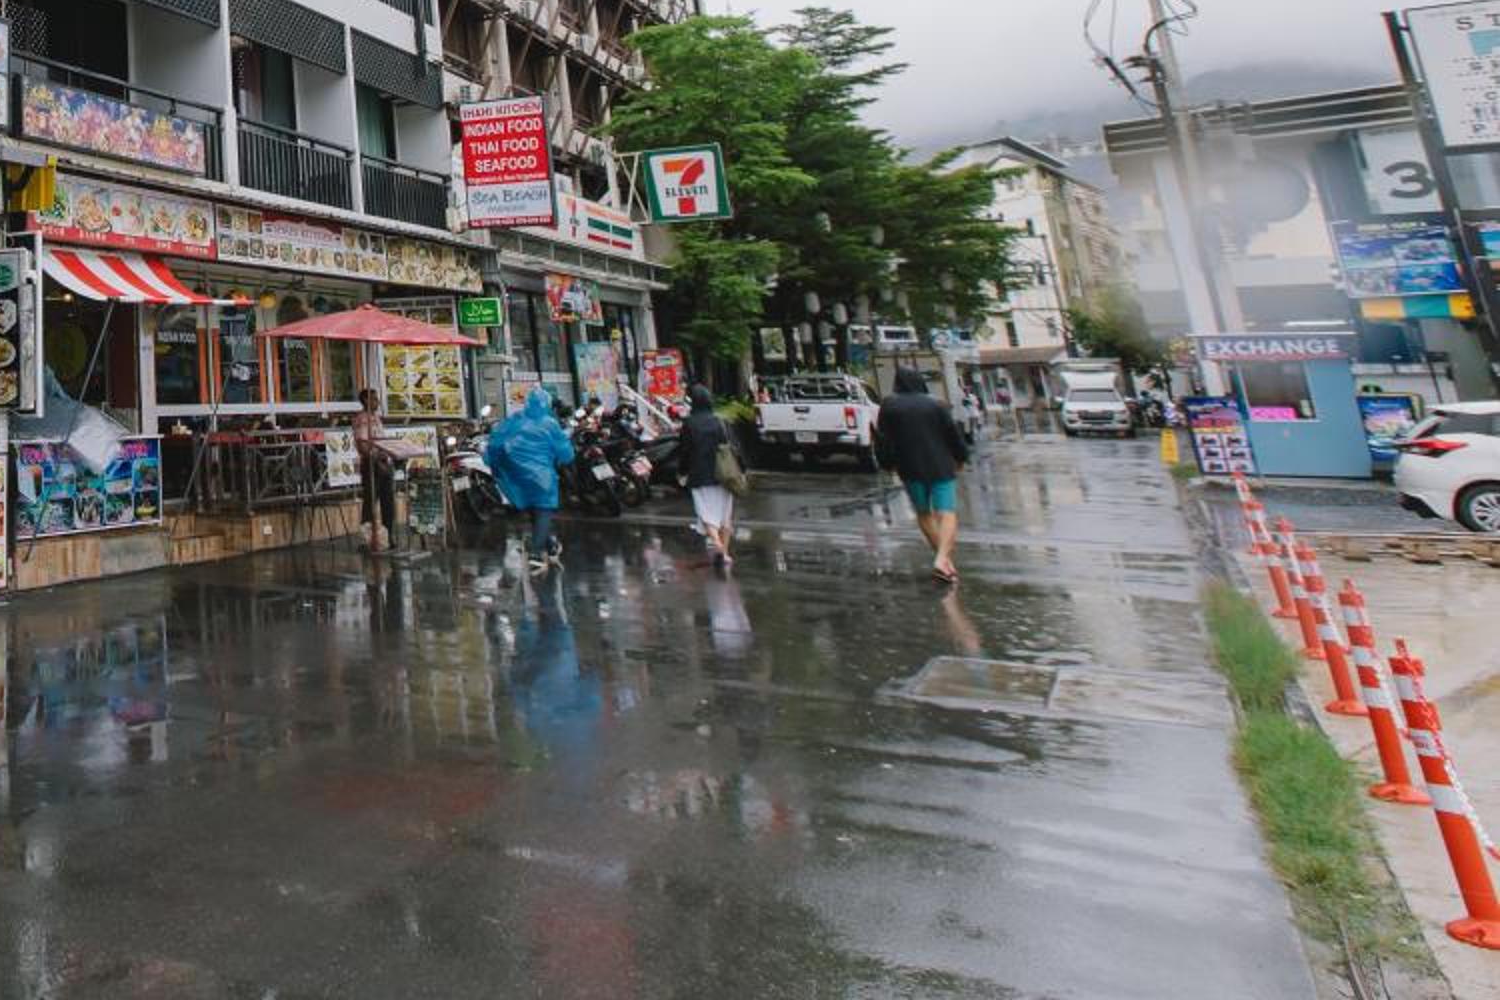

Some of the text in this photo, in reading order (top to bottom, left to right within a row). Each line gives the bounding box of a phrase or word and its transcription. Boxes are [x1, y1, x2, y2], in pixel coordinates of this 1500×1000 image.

[463, 118, 542, 137] INDIAN FOOD
[469, 137, 539, 155] THAI FOOD
[475, 155, 537, 173] SEAFOOD
[1382, 160, 1437, 199] 3
[1204, 338, 1340, 356] EXCHANGE
